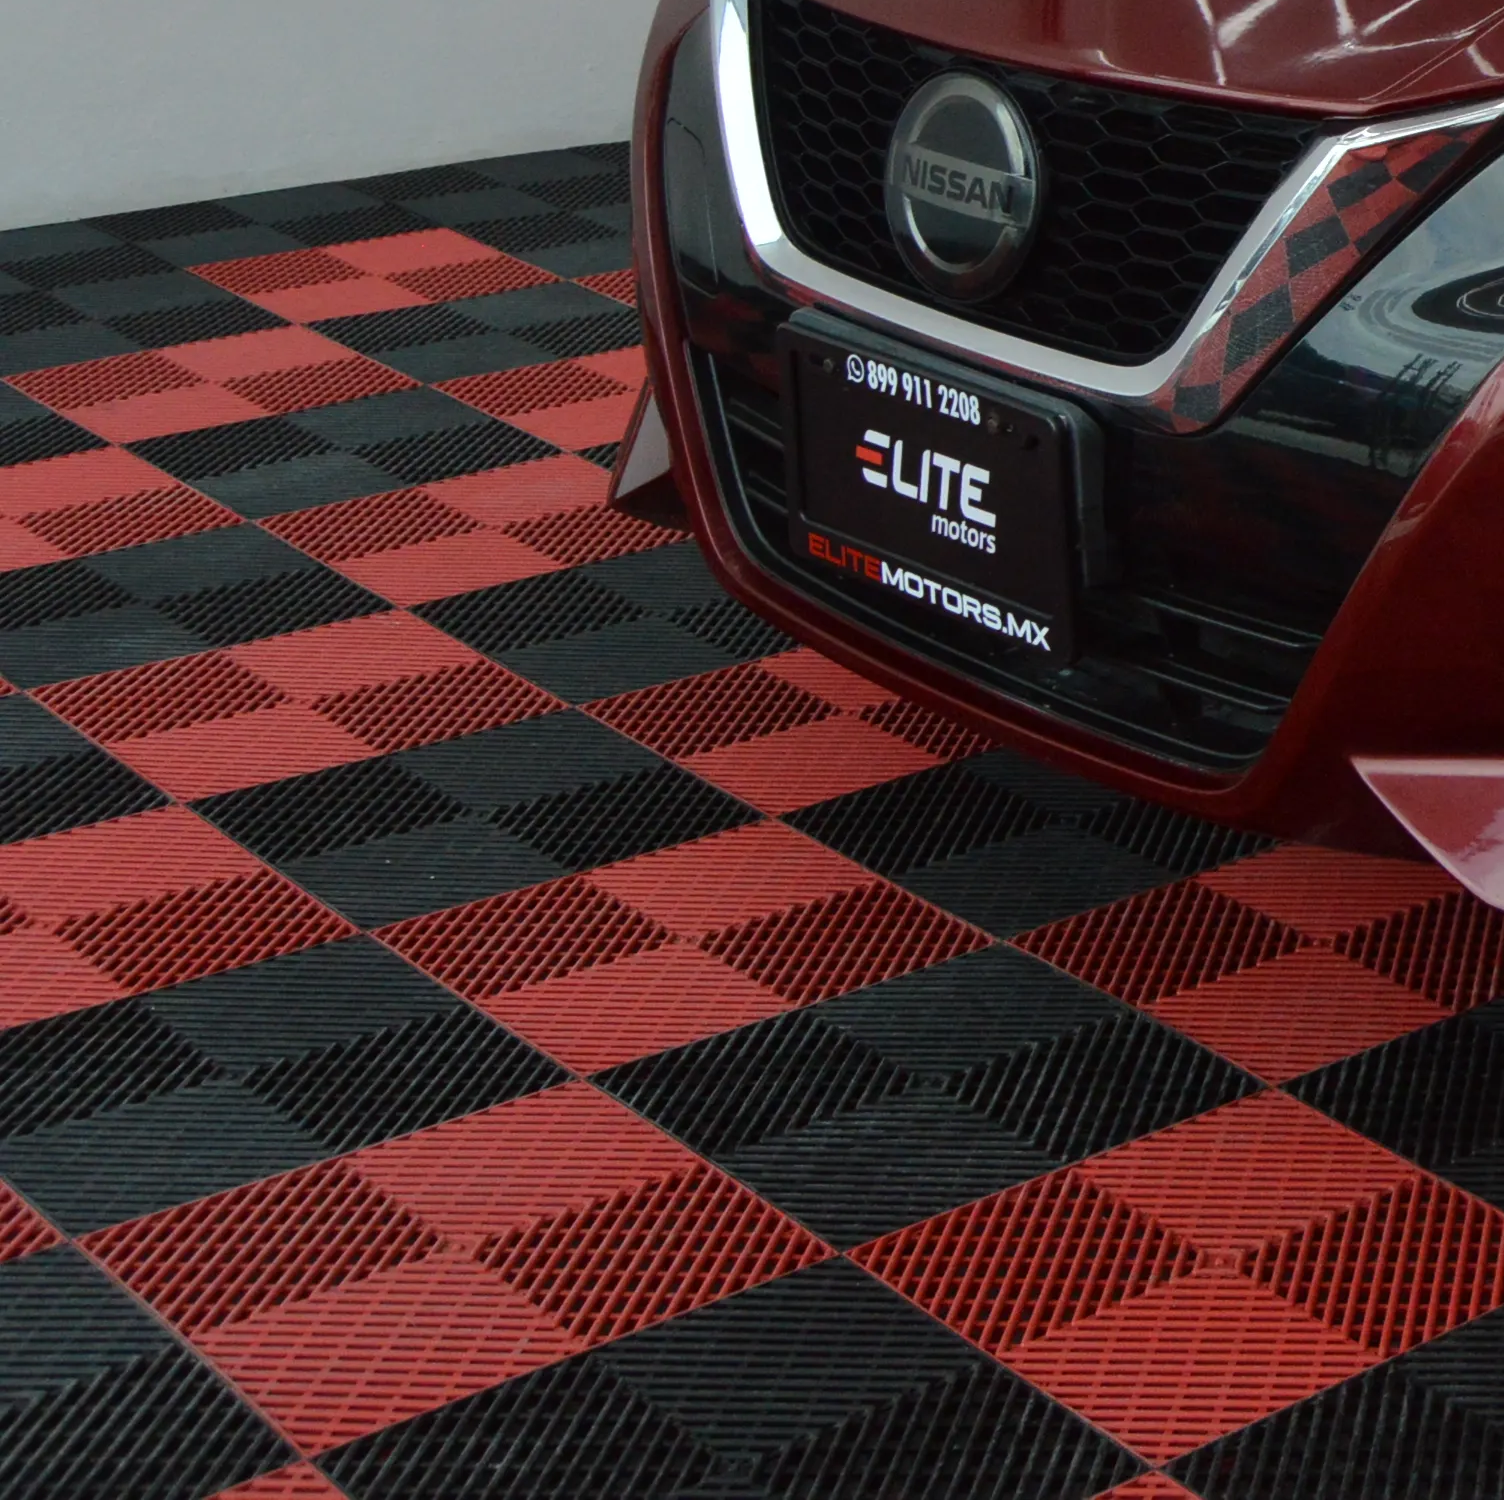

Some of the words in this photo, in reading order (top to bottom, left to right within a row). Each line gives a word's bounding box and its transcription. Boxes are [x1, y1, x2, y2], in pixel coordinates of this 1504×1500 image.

[902, 155, 1013, 214] NISSAN
[866, 359, 899, 397] 899
[901, 371, 933, 409] 911
[937, 384, 982, 425] 2208
[855, 429, 997, 528] ELITE
[931, 514, 997, 554] motors
